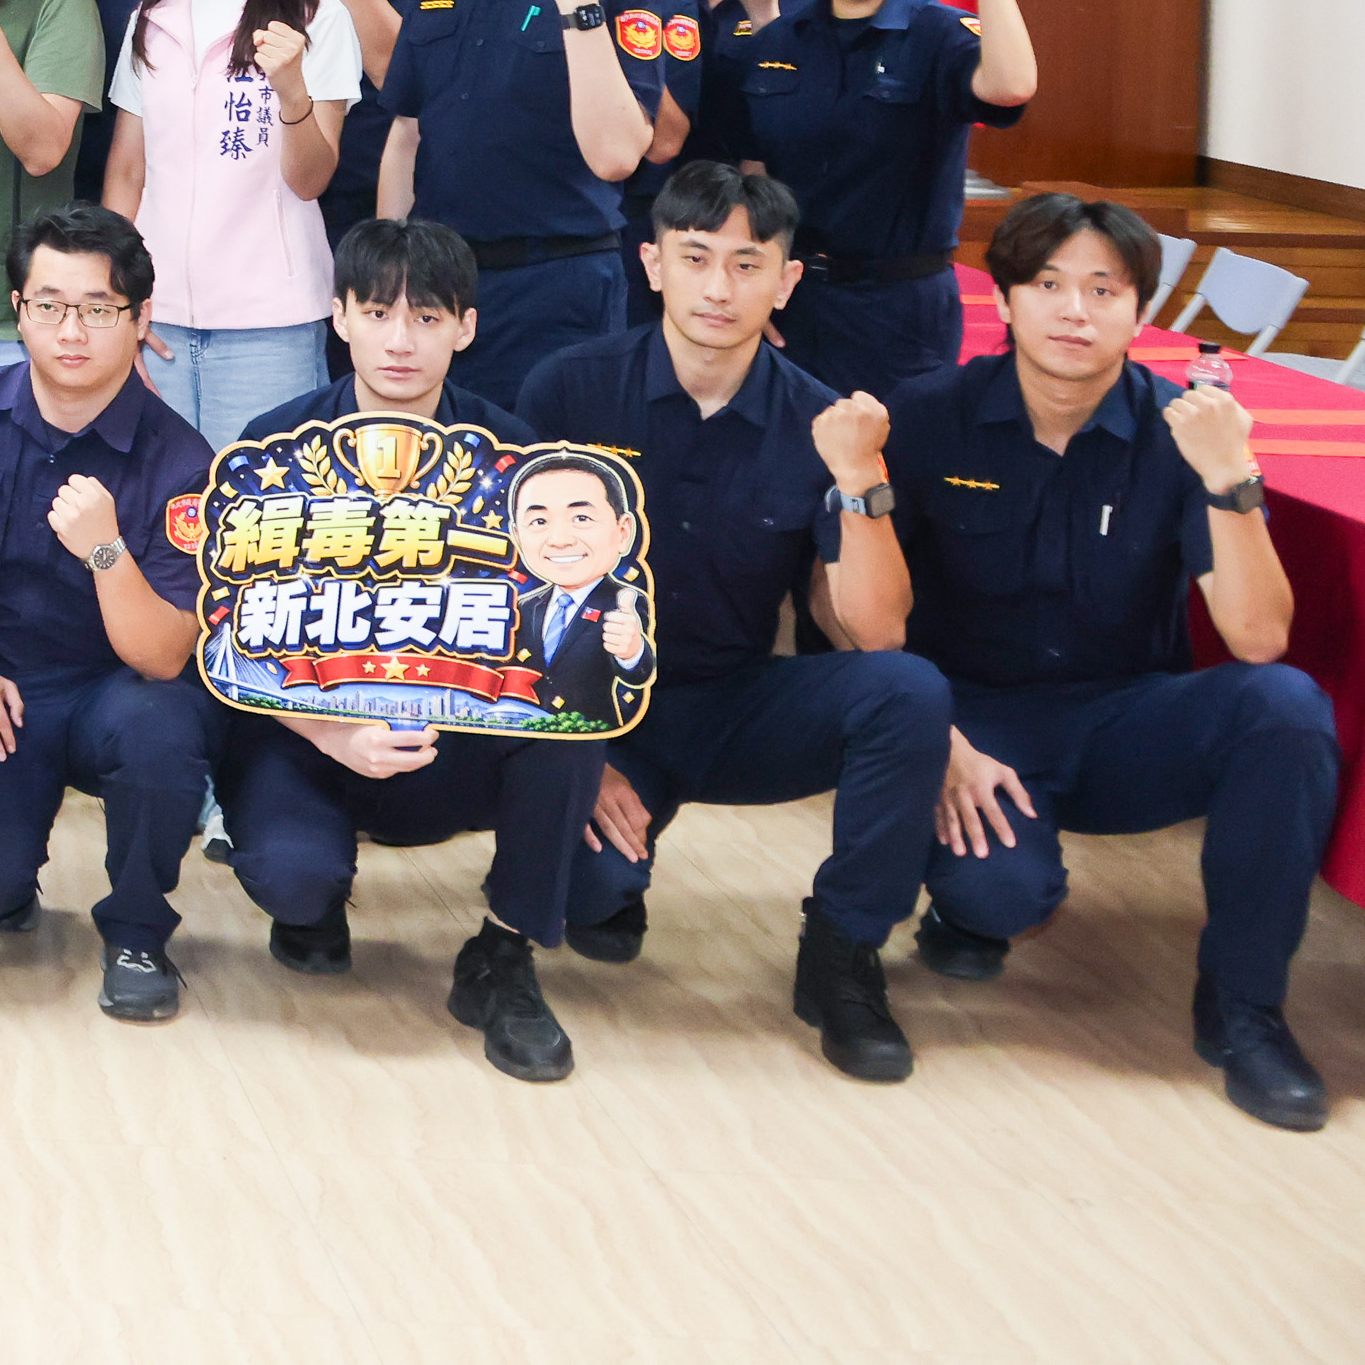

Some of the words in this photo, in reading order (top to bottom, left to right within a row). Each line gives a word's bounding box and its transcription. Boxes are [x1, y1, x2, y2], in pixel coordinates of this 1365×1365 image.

[256, 71, 275, 148] 市議員
[218, 496, 509, 572] 緝毒第一
[237, 580, 511, 651] 新北安居
